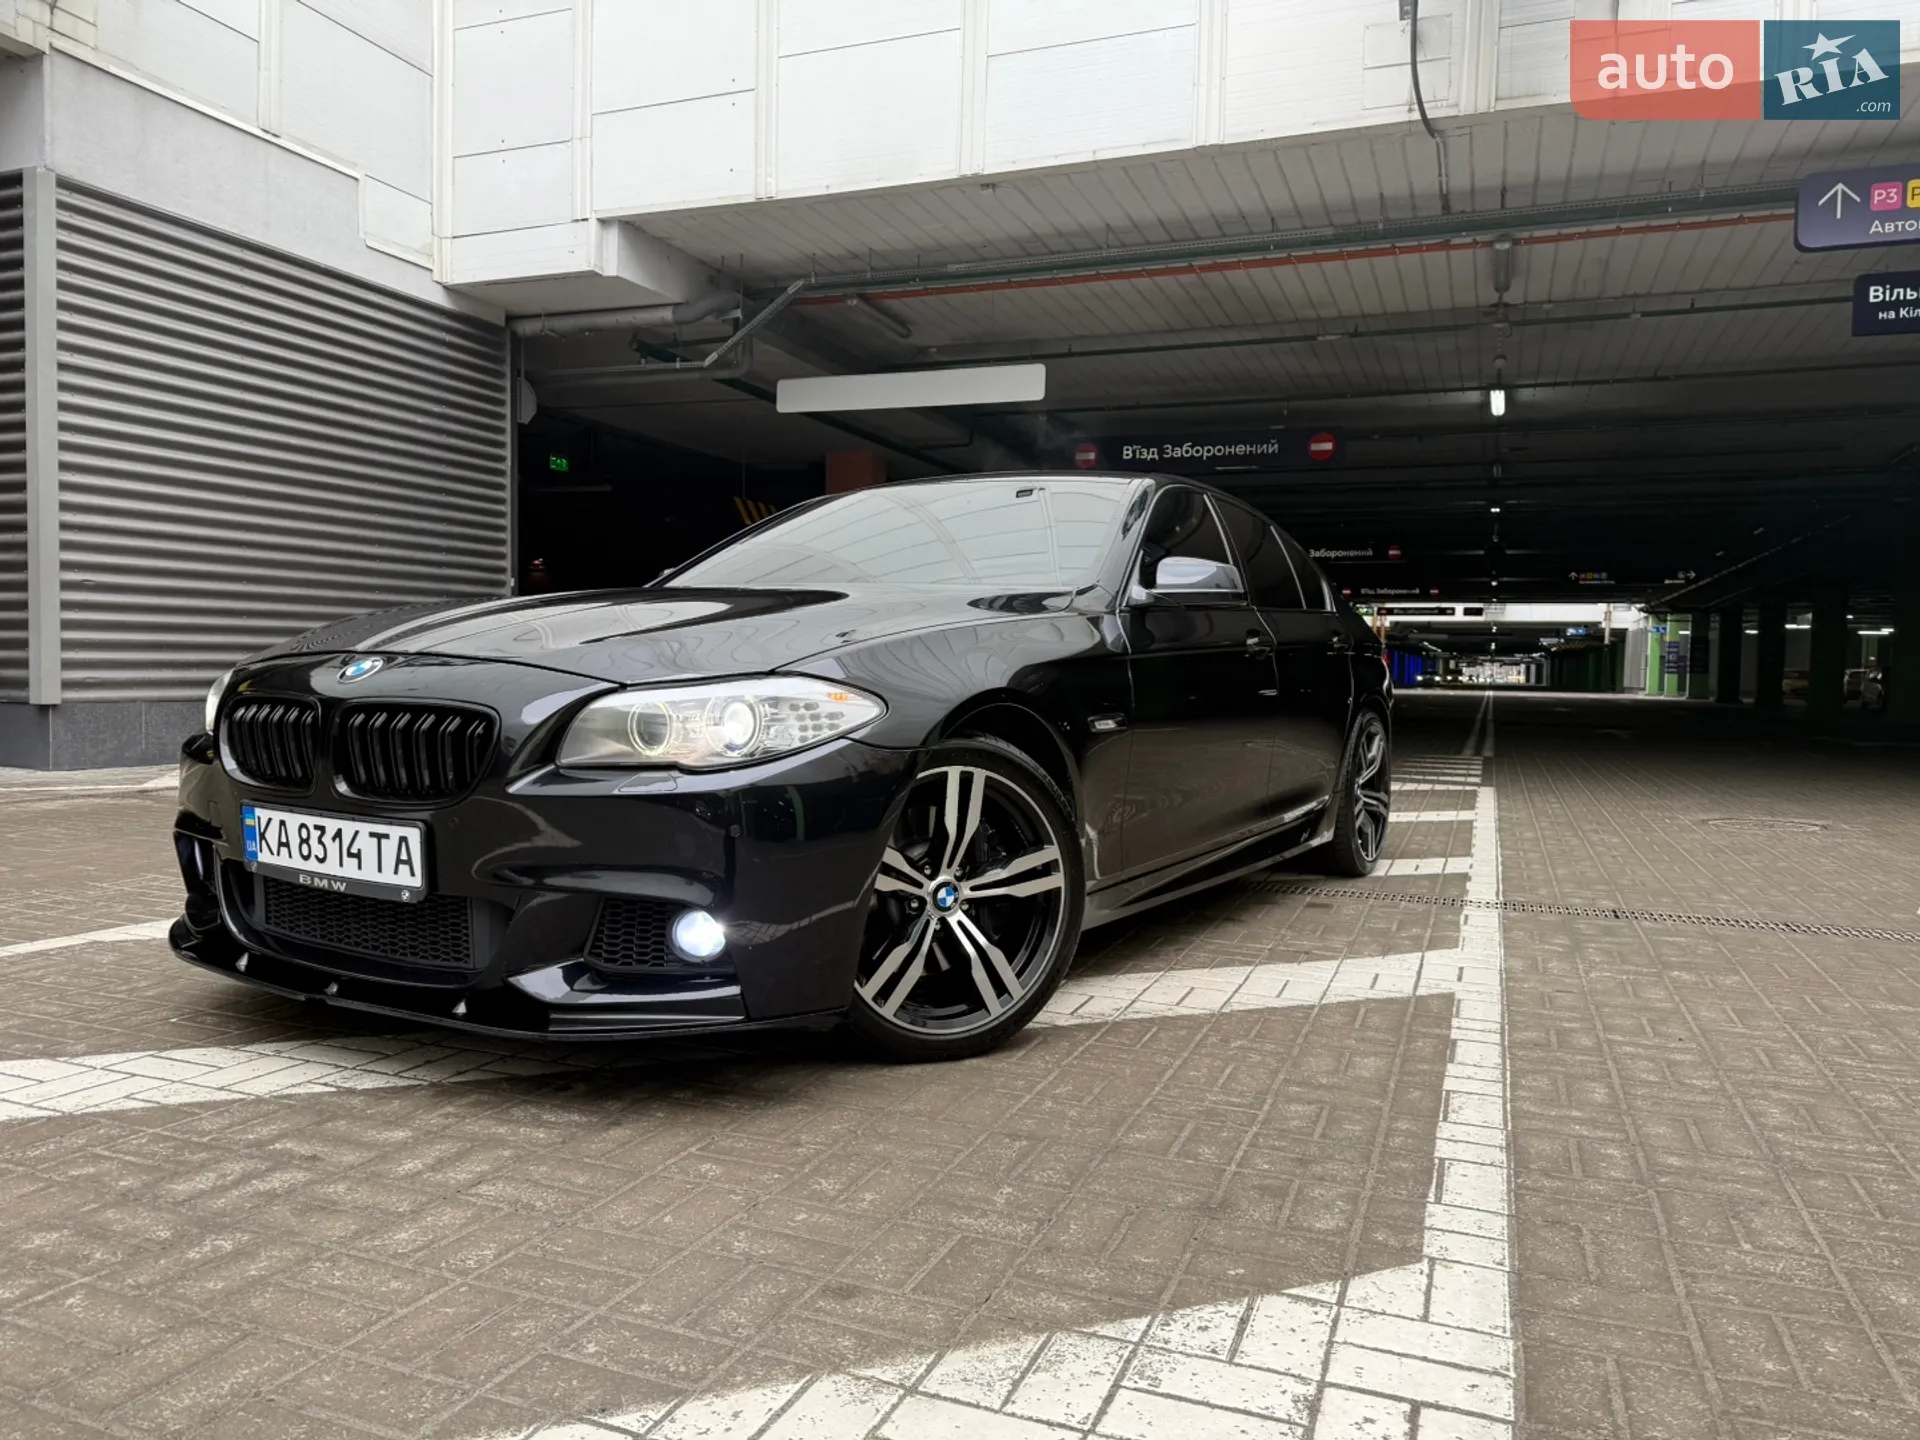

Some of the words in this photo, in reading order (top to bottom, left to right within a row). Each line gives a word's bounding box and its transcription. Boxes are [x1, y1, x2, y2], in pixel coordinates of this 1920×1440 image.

[1873, 188, 1898, 205] P3
[1869, 219, 1920, 234] Авто
[1869, 284, 1920, 303] Віль
[1878, 310, 1896, 320] на
[1162, 439, 1279, 461] Заборонений
[299, 874, 347, 892] BMW
